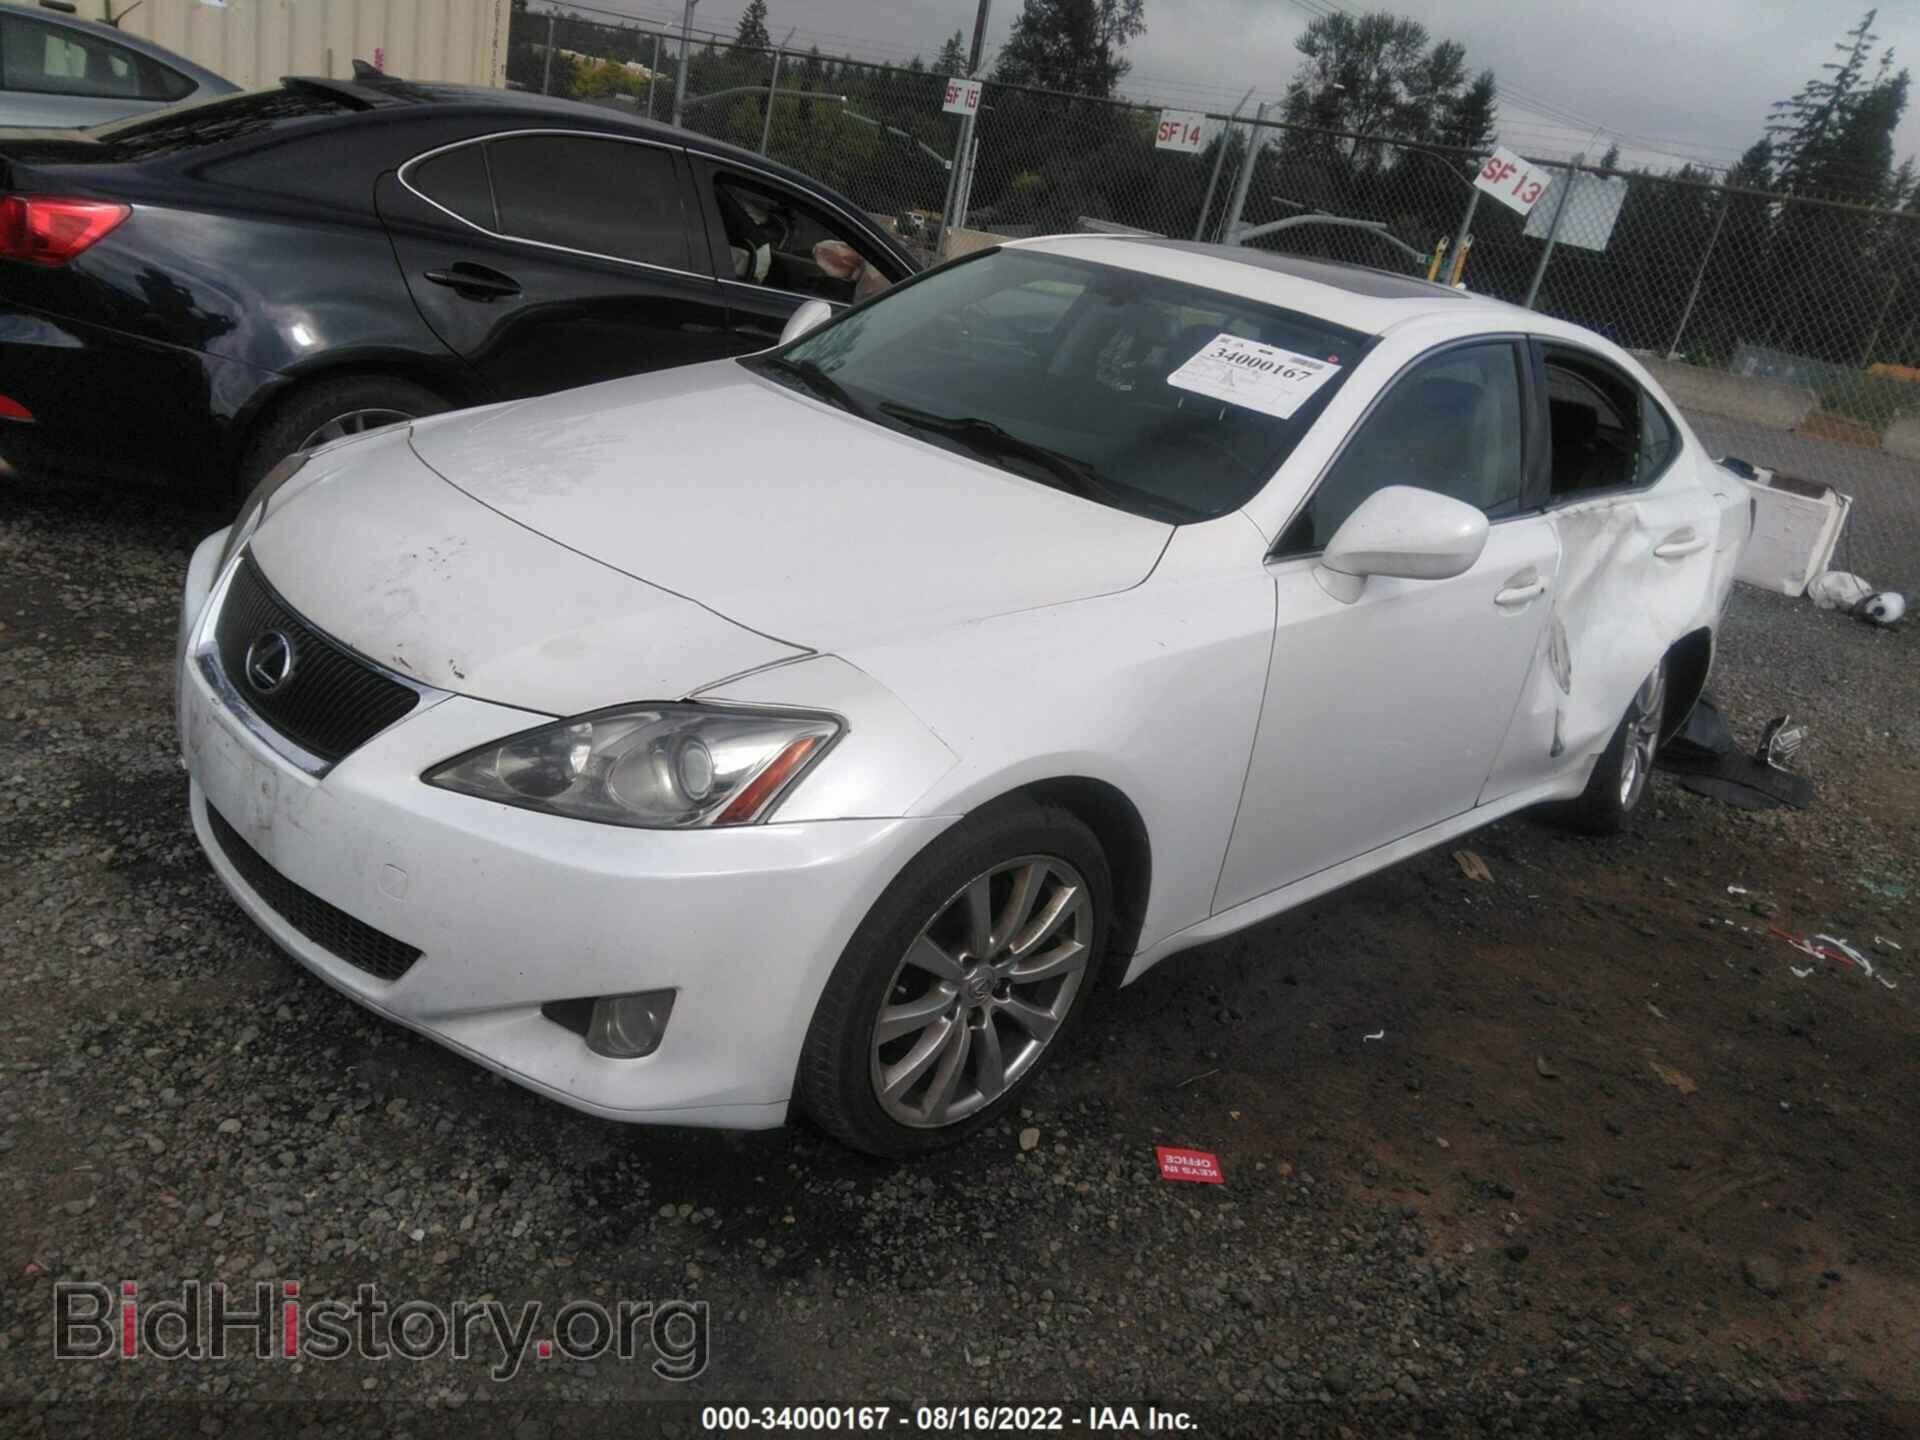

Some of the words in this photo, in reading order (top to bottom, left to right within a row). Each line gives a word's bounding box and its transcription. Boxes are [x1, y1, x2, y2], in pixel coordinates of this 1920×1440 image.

[945, 86, 960, 104] SF
[1158, 121, 1181, 142] SF
[1181, 123, 1201, 145] 14
[1481, 158, 1517, 184] SF
[1511, 173, 1542, 203] 13
[1210, 347, 1312, 382] 34000167
[1165, 1154, 1211, 1168] OFFICE
[1182, 1167, 1217, 1177] KEYS
